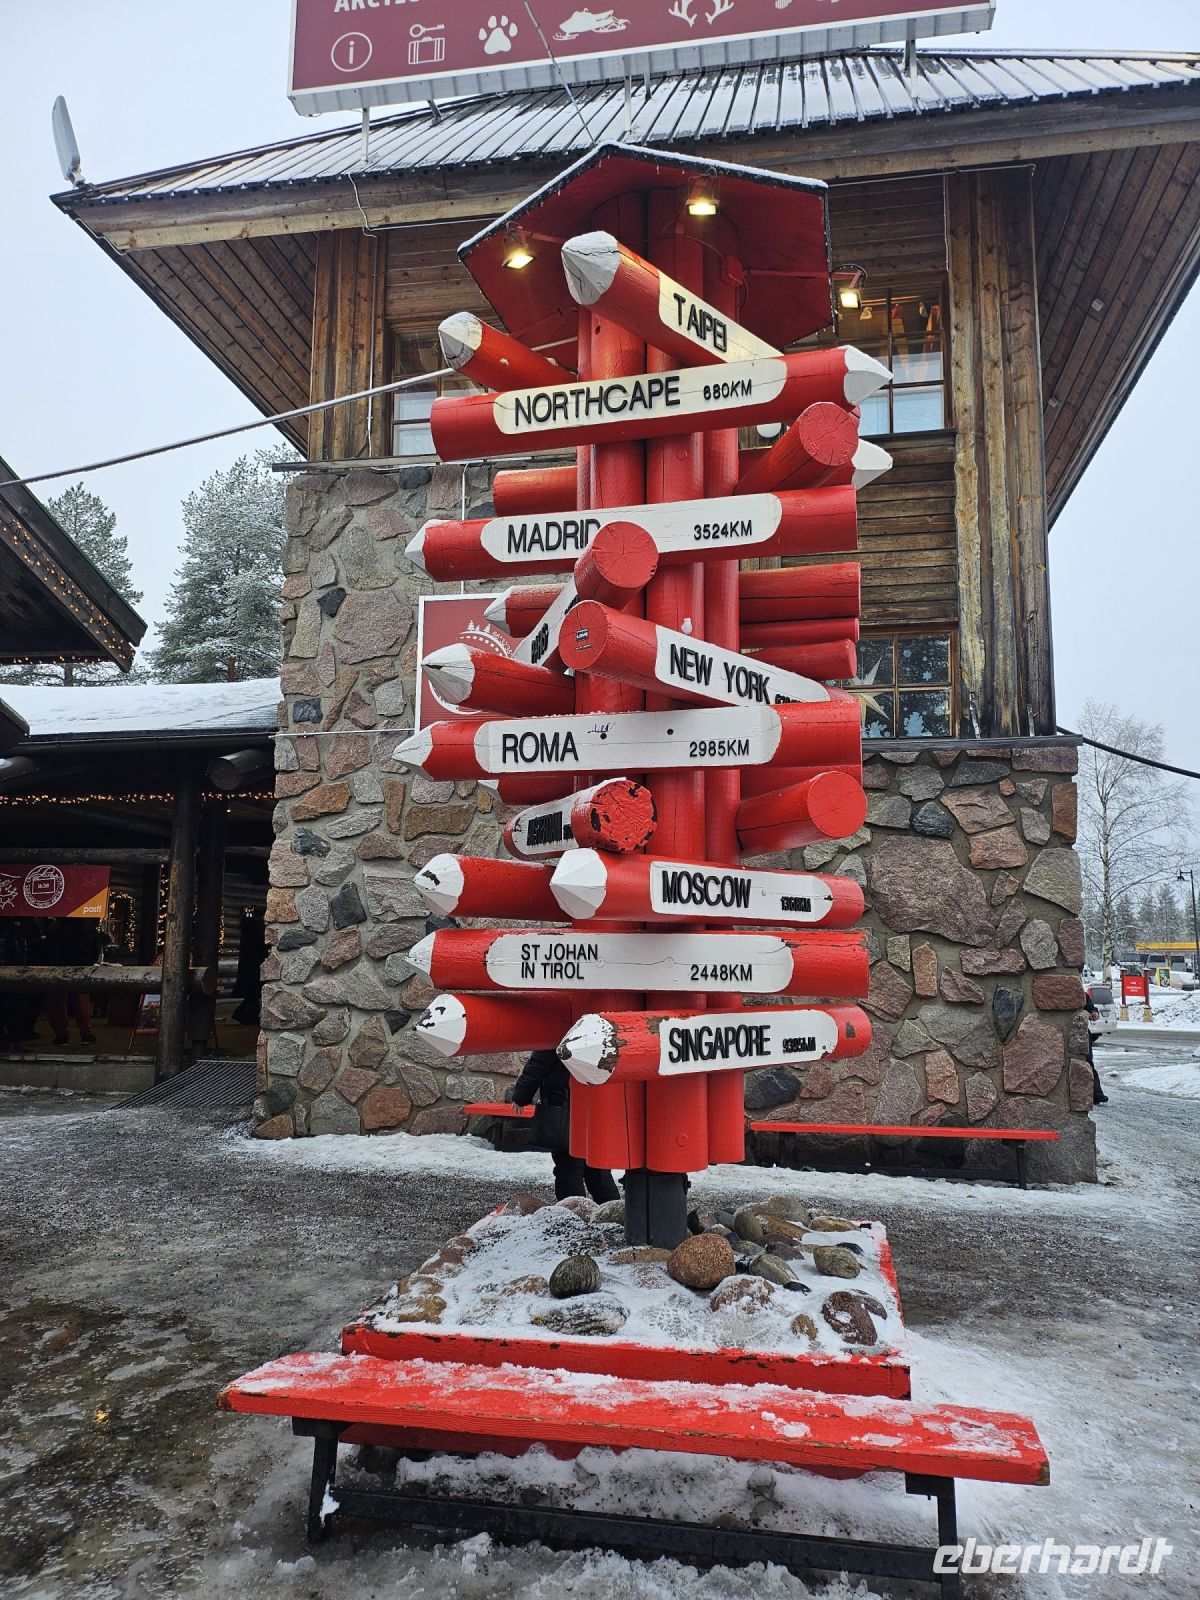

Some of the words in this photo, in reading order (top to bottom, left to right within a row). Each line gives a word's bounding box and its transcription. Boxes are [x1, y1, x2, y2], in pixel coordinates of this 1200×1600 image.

[673, 292, 727, 353] TAIPEI
[514, 375, 681, 427] NORTHCAPE
[693, 520, 752, 541] 3524KM
[670, 643, 713, 686] NEW
[723, 662, 770, 704] YORK
[502, 731, 579, 764] ROMA
[689, 739, 750, 757] 2985KM
[662, 870, 751, 908] MOSCOW
[521, 944, 540, 960] ST
[544, 943, 598, 961] JOHAN
[521, 963, 535, 979] IN
[541, 962, 584, 980] TIROL
[690, 964, 752, 981] 2448KM
[669, 1024, 771, 1063] SINGAPORE
